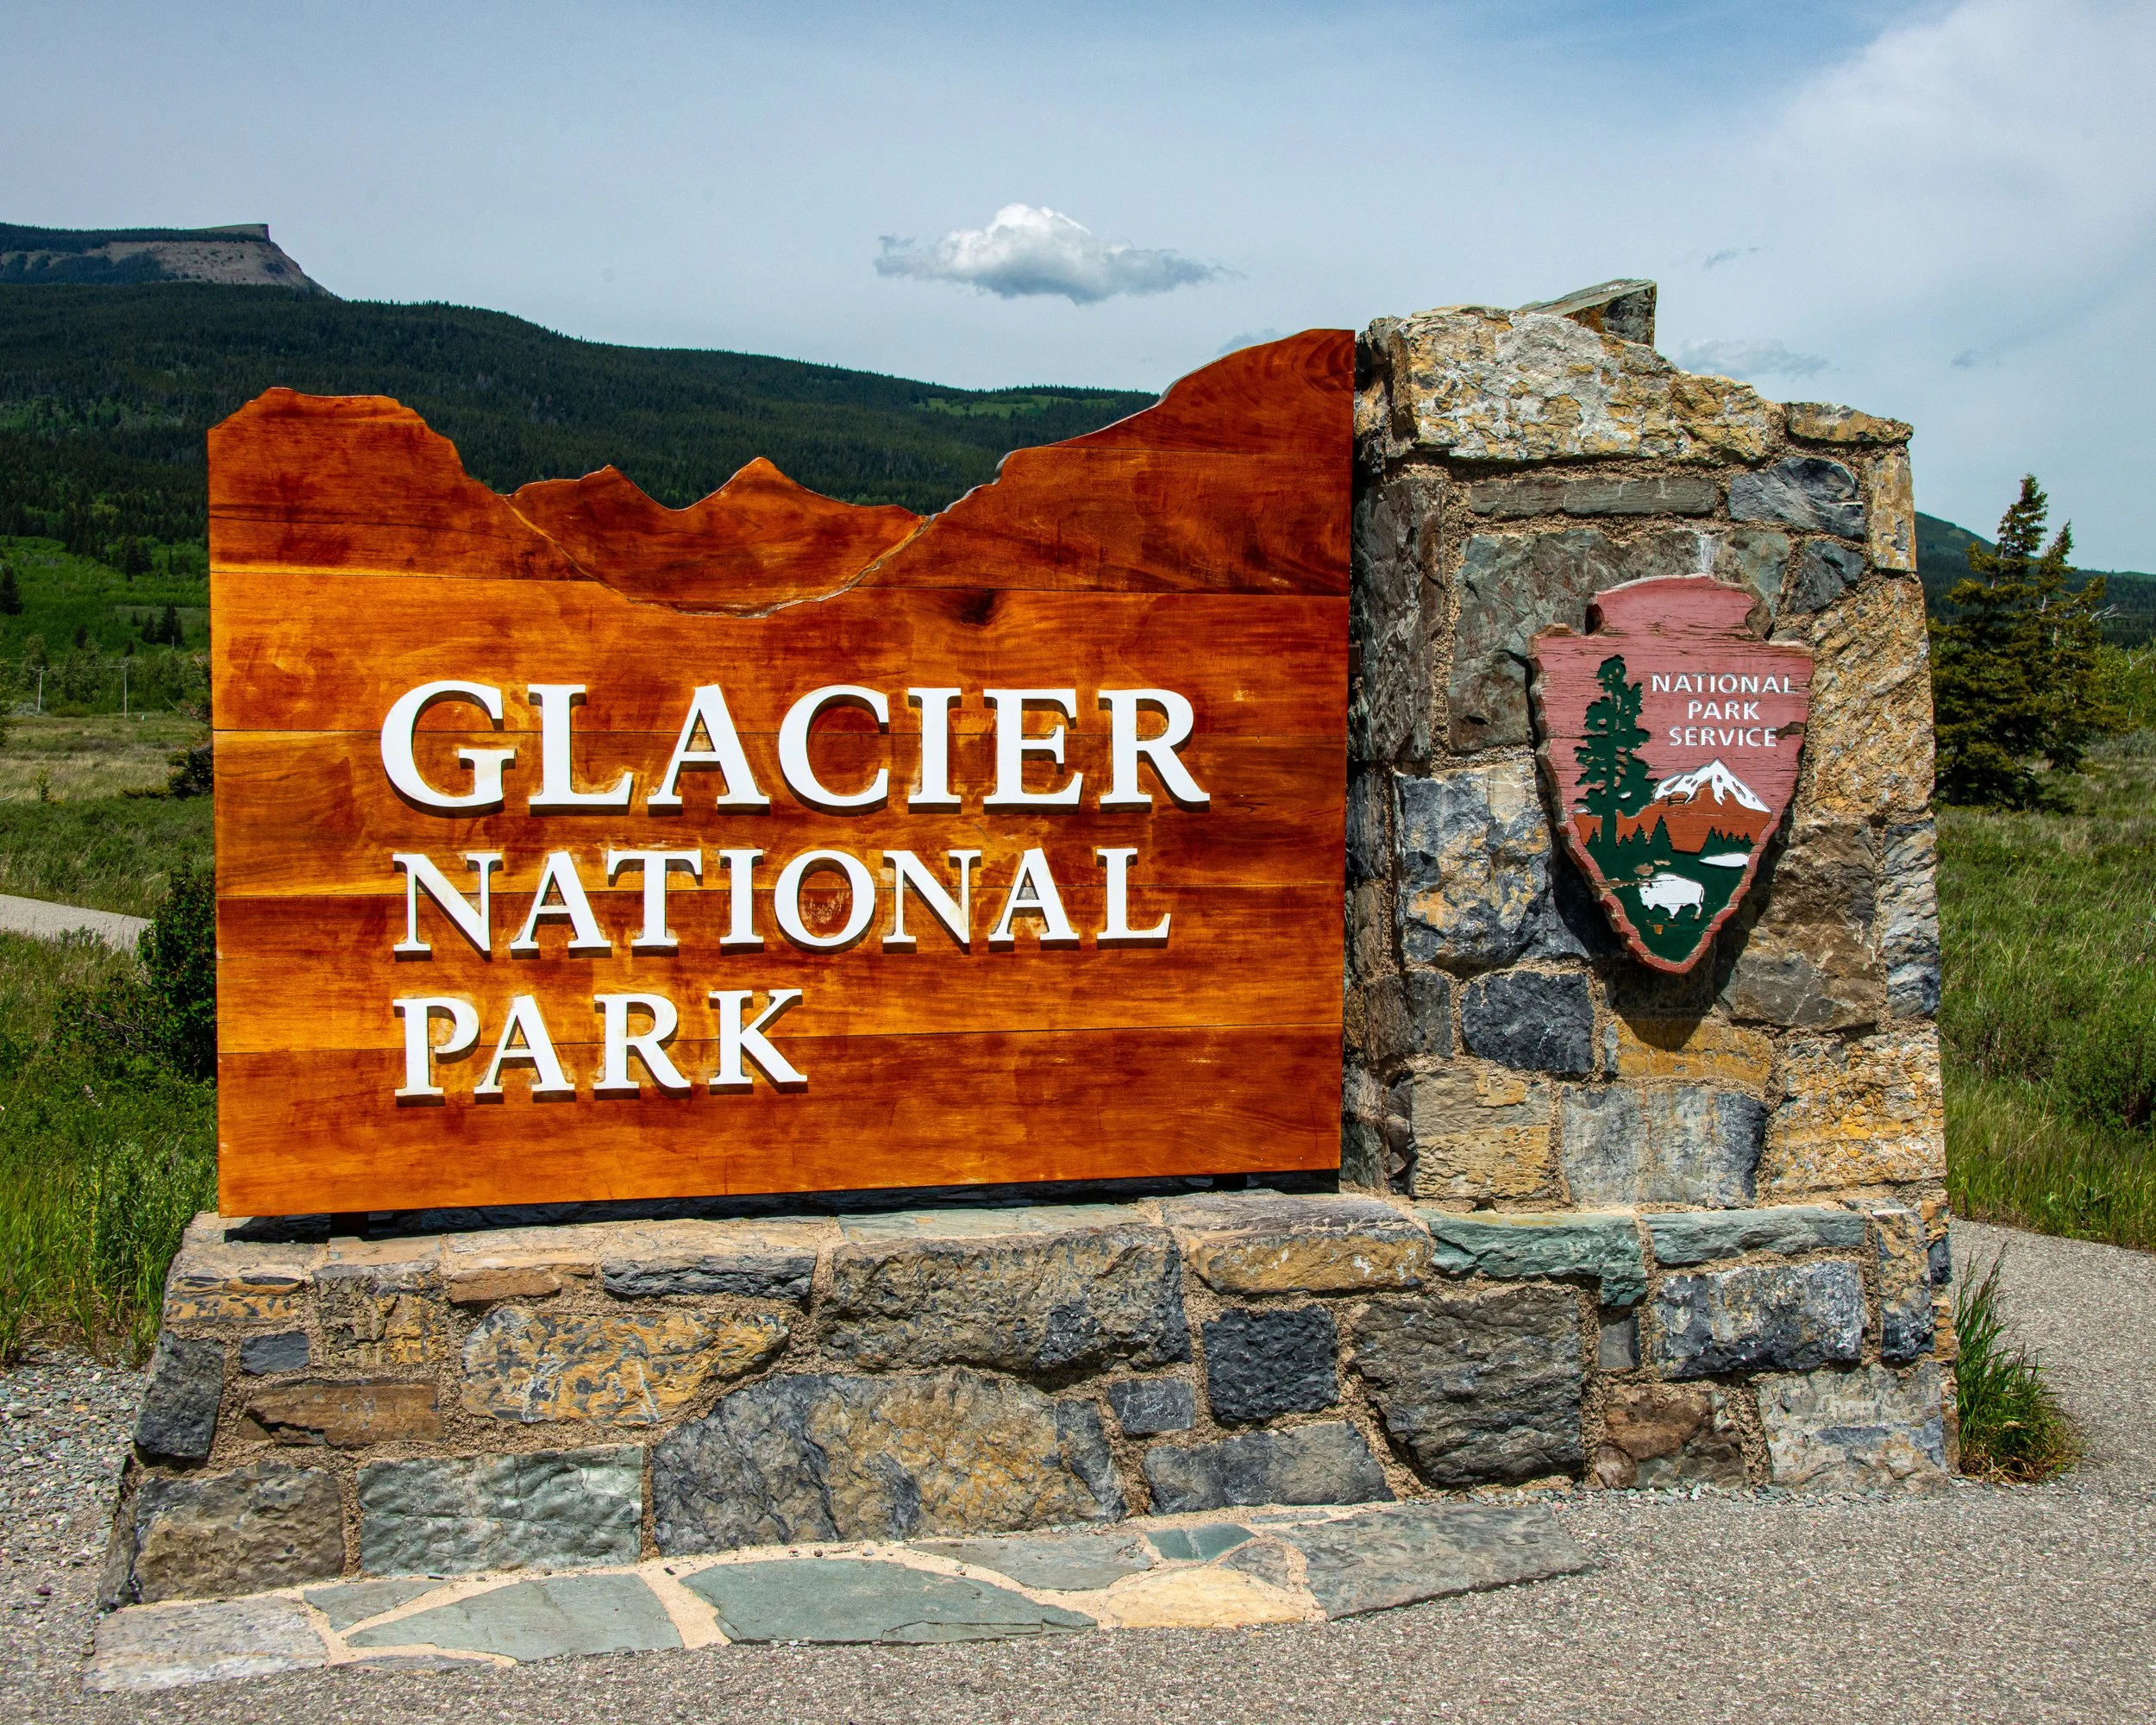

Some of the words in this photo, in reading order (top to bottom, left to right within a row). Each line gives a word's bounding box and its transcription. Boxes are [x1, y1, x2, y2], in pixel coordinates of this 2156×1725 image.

[1651, 673, 1796, 693] NATIONAL
[1688, 700, 1761, 720] PARK
[379, 680, 1210, 809] GLACIER
[1668, 726, 1777, 747] SERVICE
[392, 847, 1171, 953] NATIONAL
[392, 988, 808, 1097] PARK
